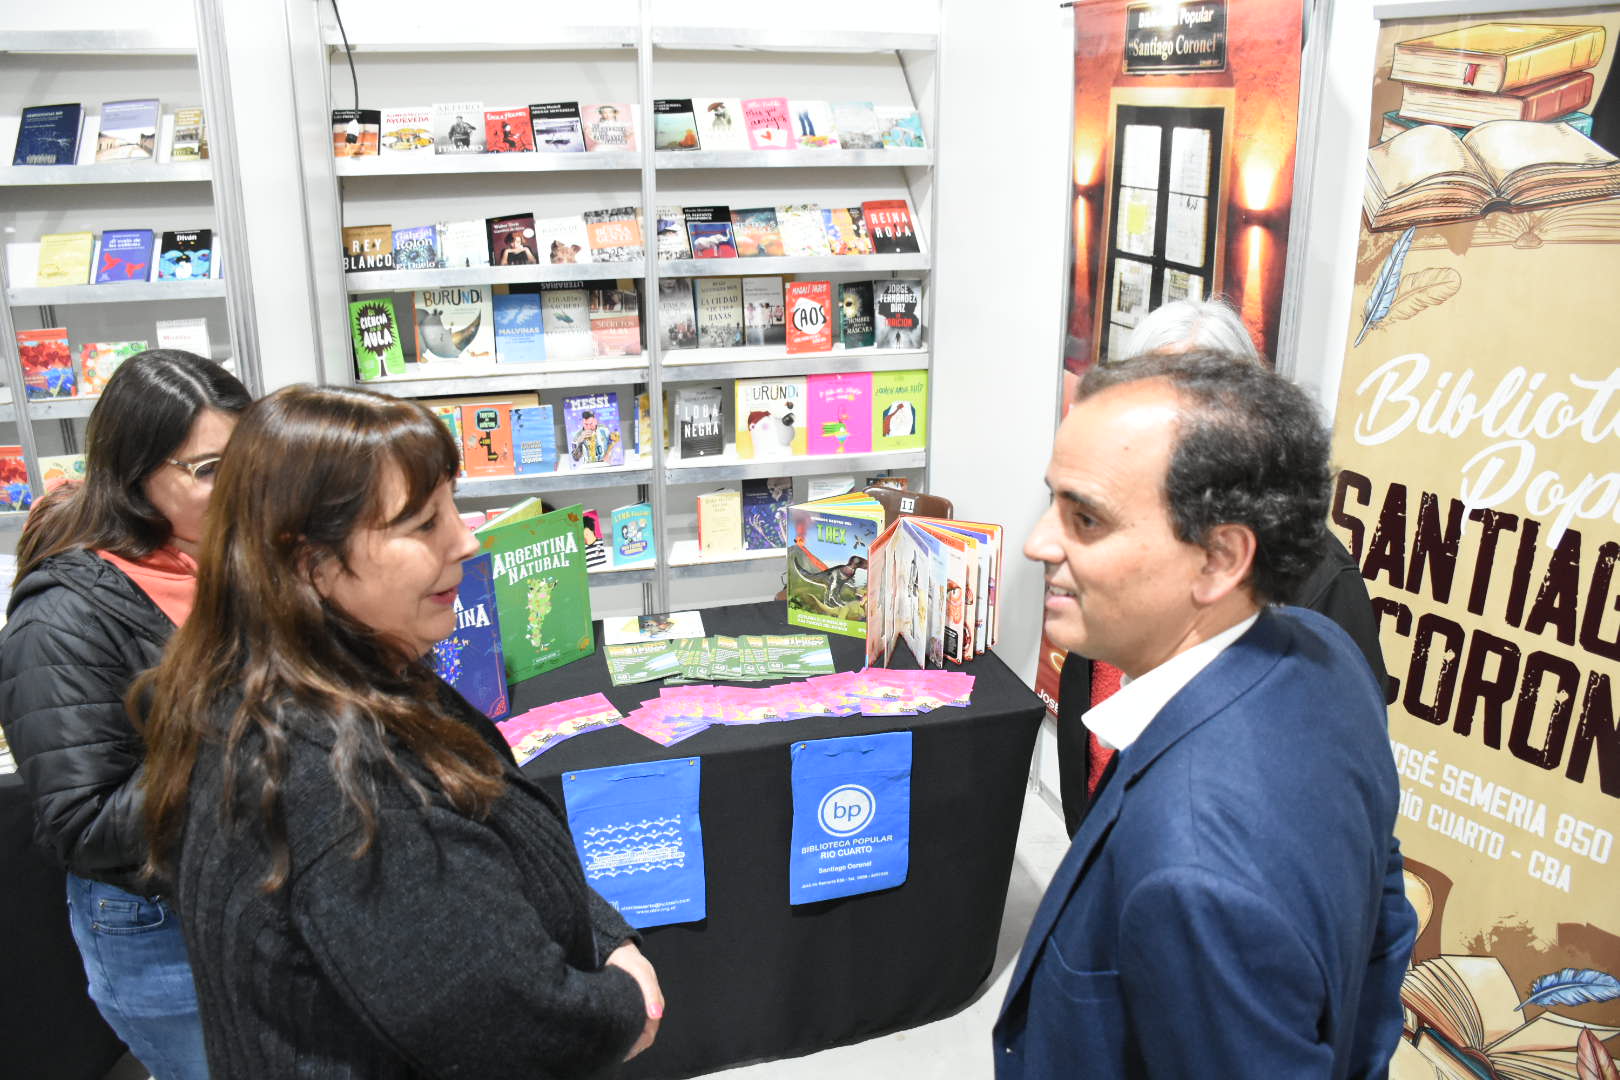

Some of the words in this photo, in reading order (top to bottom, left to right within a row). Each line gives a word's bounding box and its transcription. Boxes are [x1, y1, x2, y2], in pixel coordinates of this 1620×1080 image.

[1180, 6, 1215, 29] Popular
[870, 211, 909, 225] REINA
[874, 226, 912, 238] ROJA
[352, 238, 382, 253] REY
[343, 253, 392, 270] BLANCO
[541, 280, 584, 290] LITERARIAS
[887, 284, 909, 294] JORGE
[423, 289, 483, 307] BURUNDI
[792, 305, 827, 332] CAOS
[363, 328, 393, 348] AULA
[498, 327, 540, 335] MALVINAS
[571, 395, 611, 410] MESSI
[684, 423, 719, 438] NEGRA
[493, 532, 578, 579] ARGENTINA
[507, 552, 570, 585] NATURAL
[833, 801, 862, 821] bp
[1440, 764, 1547, 839] SEMERIA
[1554, 813, 1613, 865] 850
[801, 839, 851, 855] BIBLIOTECA
[852, 834, 893, 846] POPULAR
[837, 845, 873, 857] CUARTO
[1427, 804, 1505, 860] CUARTO
[1527, 850, 1572, 894] CBA
[818, 864, 847, 874] Santiago
[847, 861, 872, 870] Coronel
